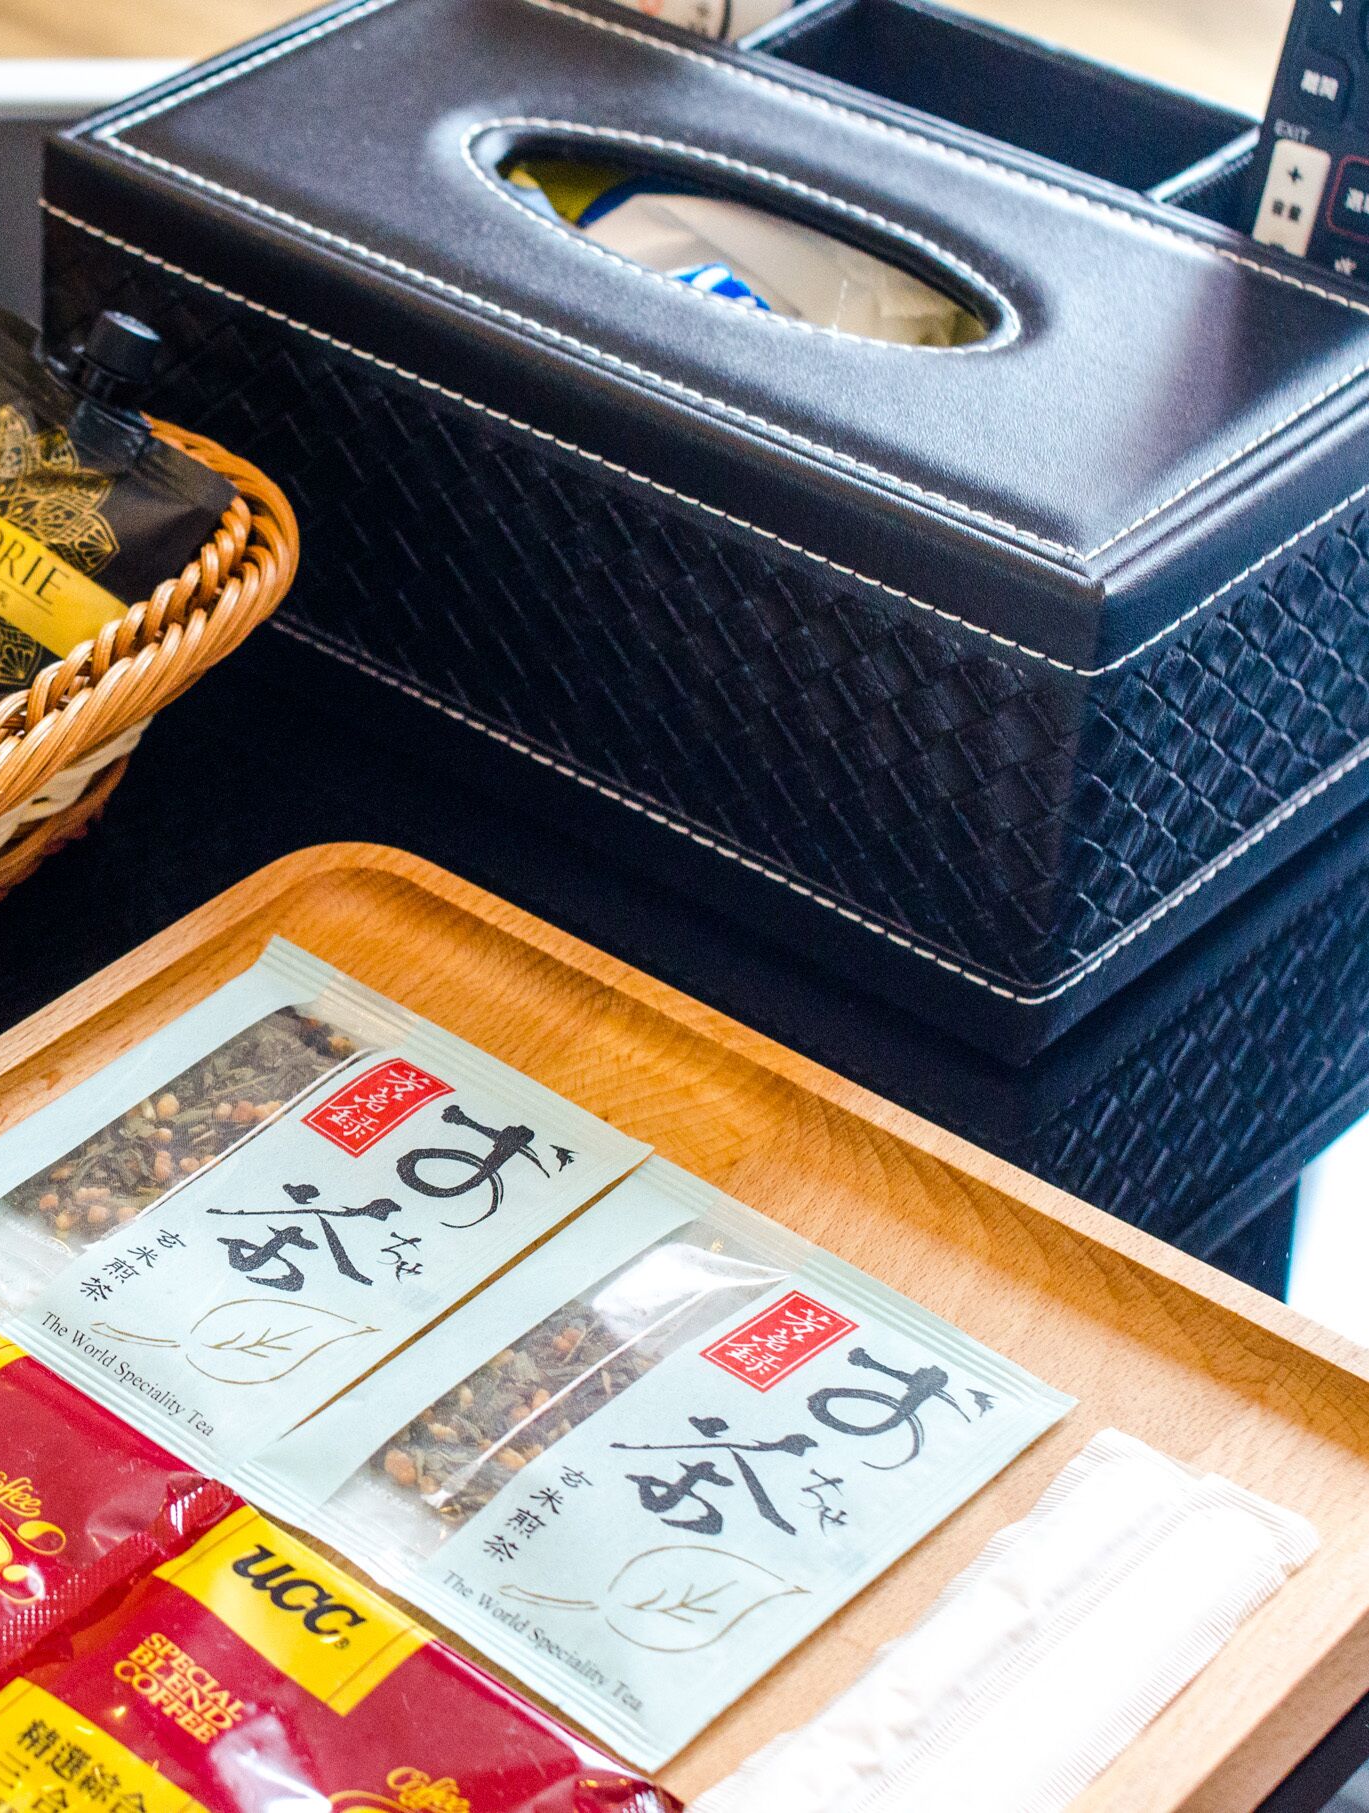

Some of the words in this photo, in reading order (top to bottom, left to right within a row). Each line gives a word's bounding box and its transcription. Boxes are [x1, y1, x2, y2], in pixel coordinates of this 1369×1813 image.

[41, 1311, 69, 1337] The
[72, 1329, 117, 1369] World
[113, 1360, 187, 1417] Speciality
[187, 1408, 215, 1438] Tea
[128, 1642, 234, 1730] BLEND
[143, 1631, 246, 1721] SPECIAL
[442, 1568, 475, 1599] The
[478, 1591, 531, 1635] World
[526, 1626, 613, 1689] Speciality
[611, 1680, 645, 1714] Tea
[113, 1660, 219, 1744] COFFEE
